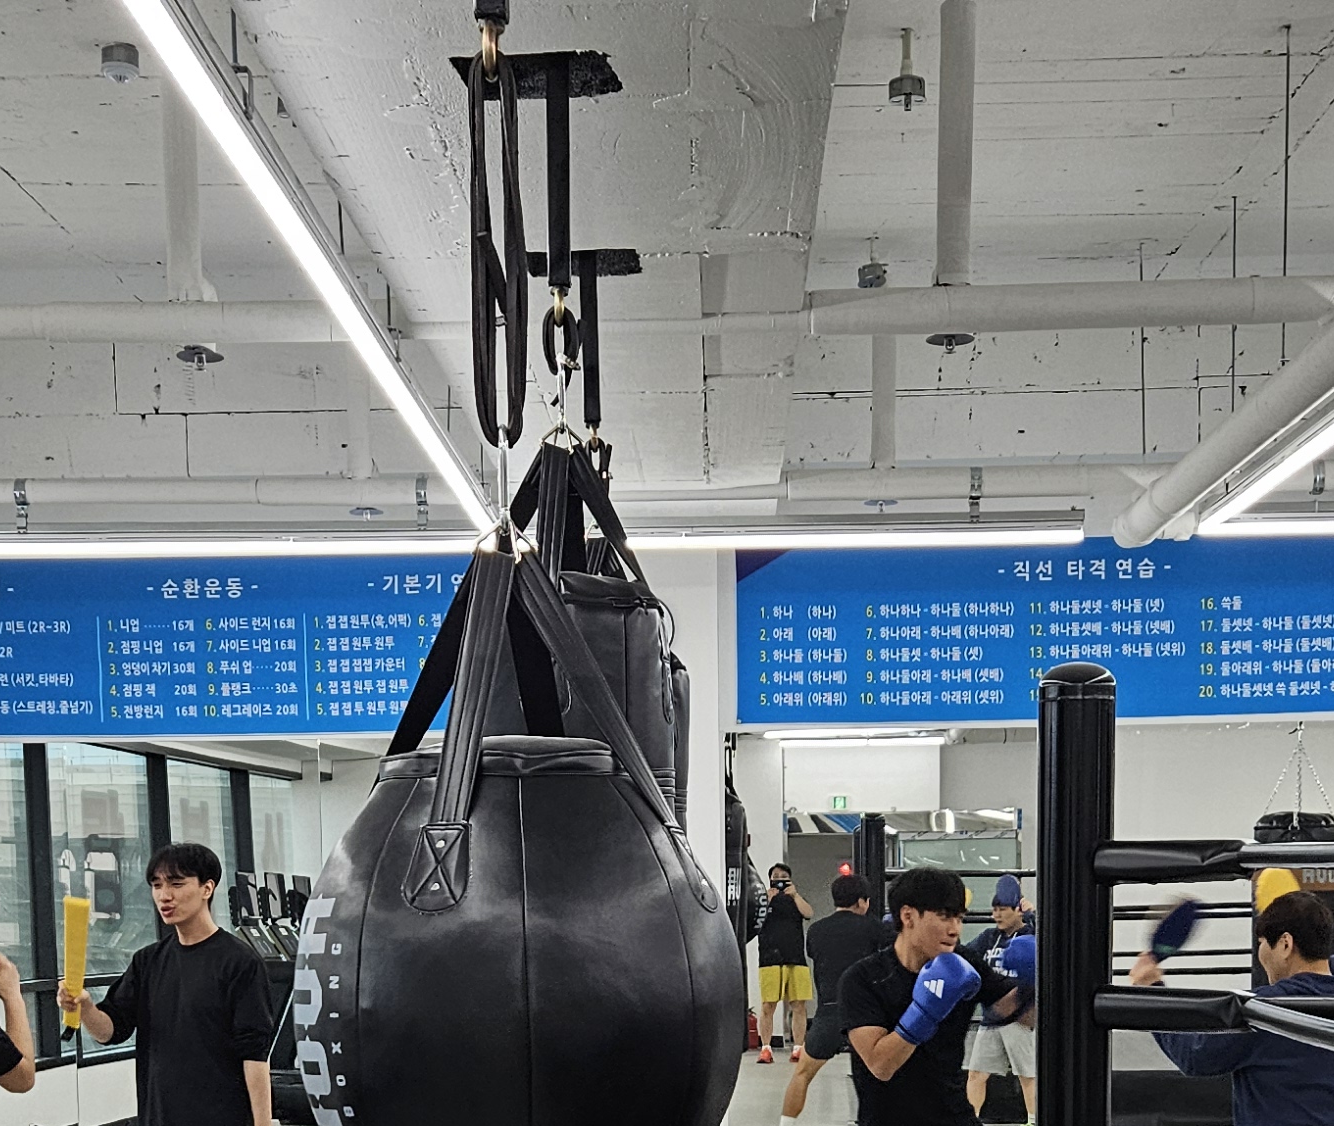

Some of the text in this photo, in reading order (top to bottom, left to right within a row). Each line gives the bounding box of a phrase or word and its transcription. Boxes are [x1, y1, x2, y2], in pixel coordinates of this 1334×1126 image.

[1014, 558, 1155, 581] 직선 타격 연습
[161, 578, 243, 598] 순환운동
[383, 574, 441, 594] 기본기
[773, 605, 793, 619] 하나
[808, 605, 836, 619] (하나)
[880, 604, 921, 618] 하나하나
[773, 627, 793, 641] 아래
[0, 647, 13, 658] 2R
[173, 662, 195, 674] 30회
[375, 657, 405, 671] 카운터
[175, 684, 196, 695] 20회
[176, 705, 197, 717] 16회
[276, 704, 298, 715] 20회
[328, 942, 356, 1118] BOXING
